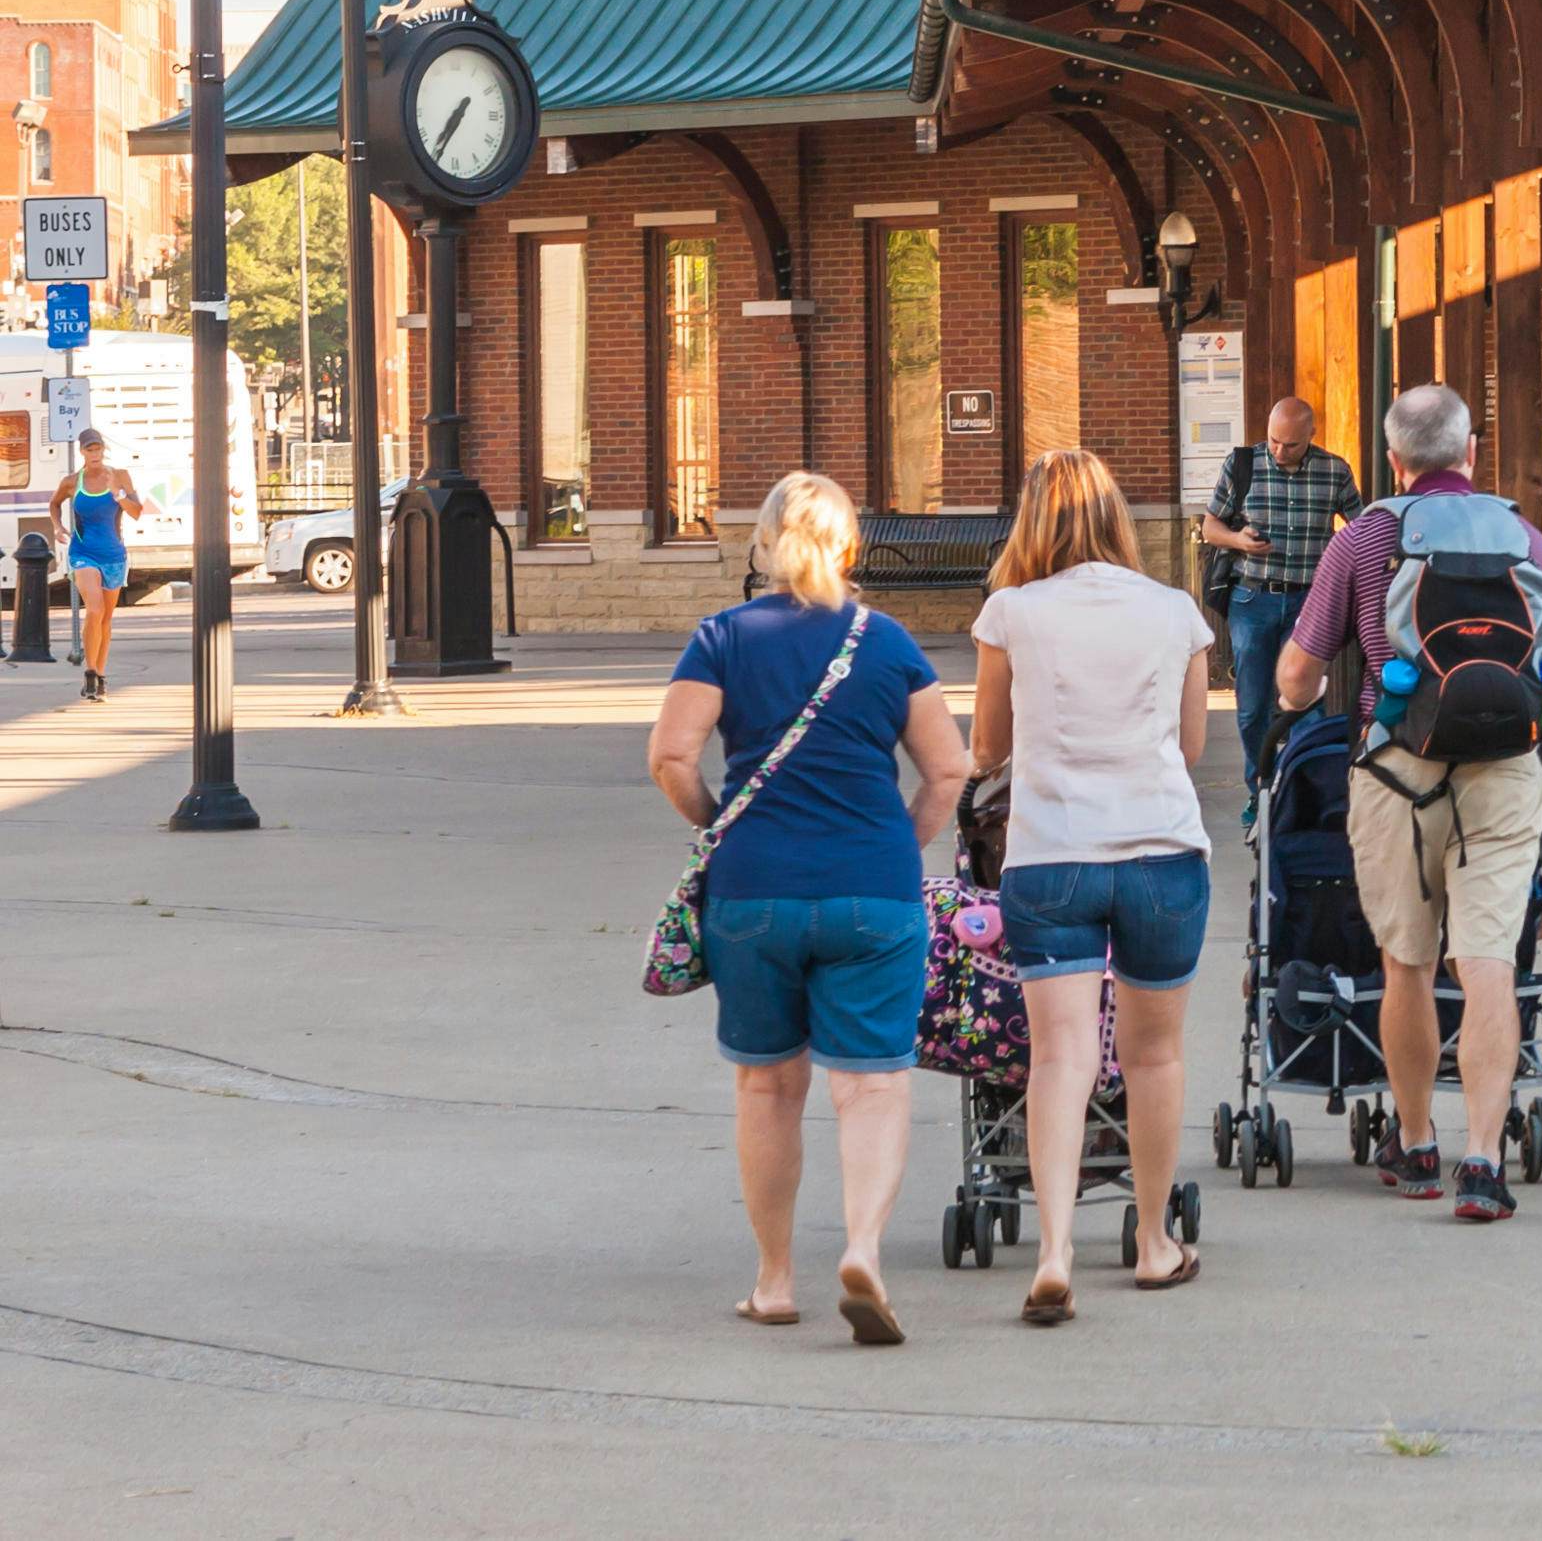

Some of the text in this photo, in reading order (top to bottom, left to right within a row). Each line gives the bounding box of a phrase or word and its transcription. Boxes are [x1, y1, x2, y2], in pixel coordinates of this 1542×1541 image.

[40, 212, 92, 232] BUSES
[44, 247, 85, 267] ONLY
[54, 308, 79, 321] BUS
[53, 321, 89, 334] STOP
[962, 396, 979, 412] NO
[59, 405, 80, 417] Bay
[66, 420, 73, 430] 1
